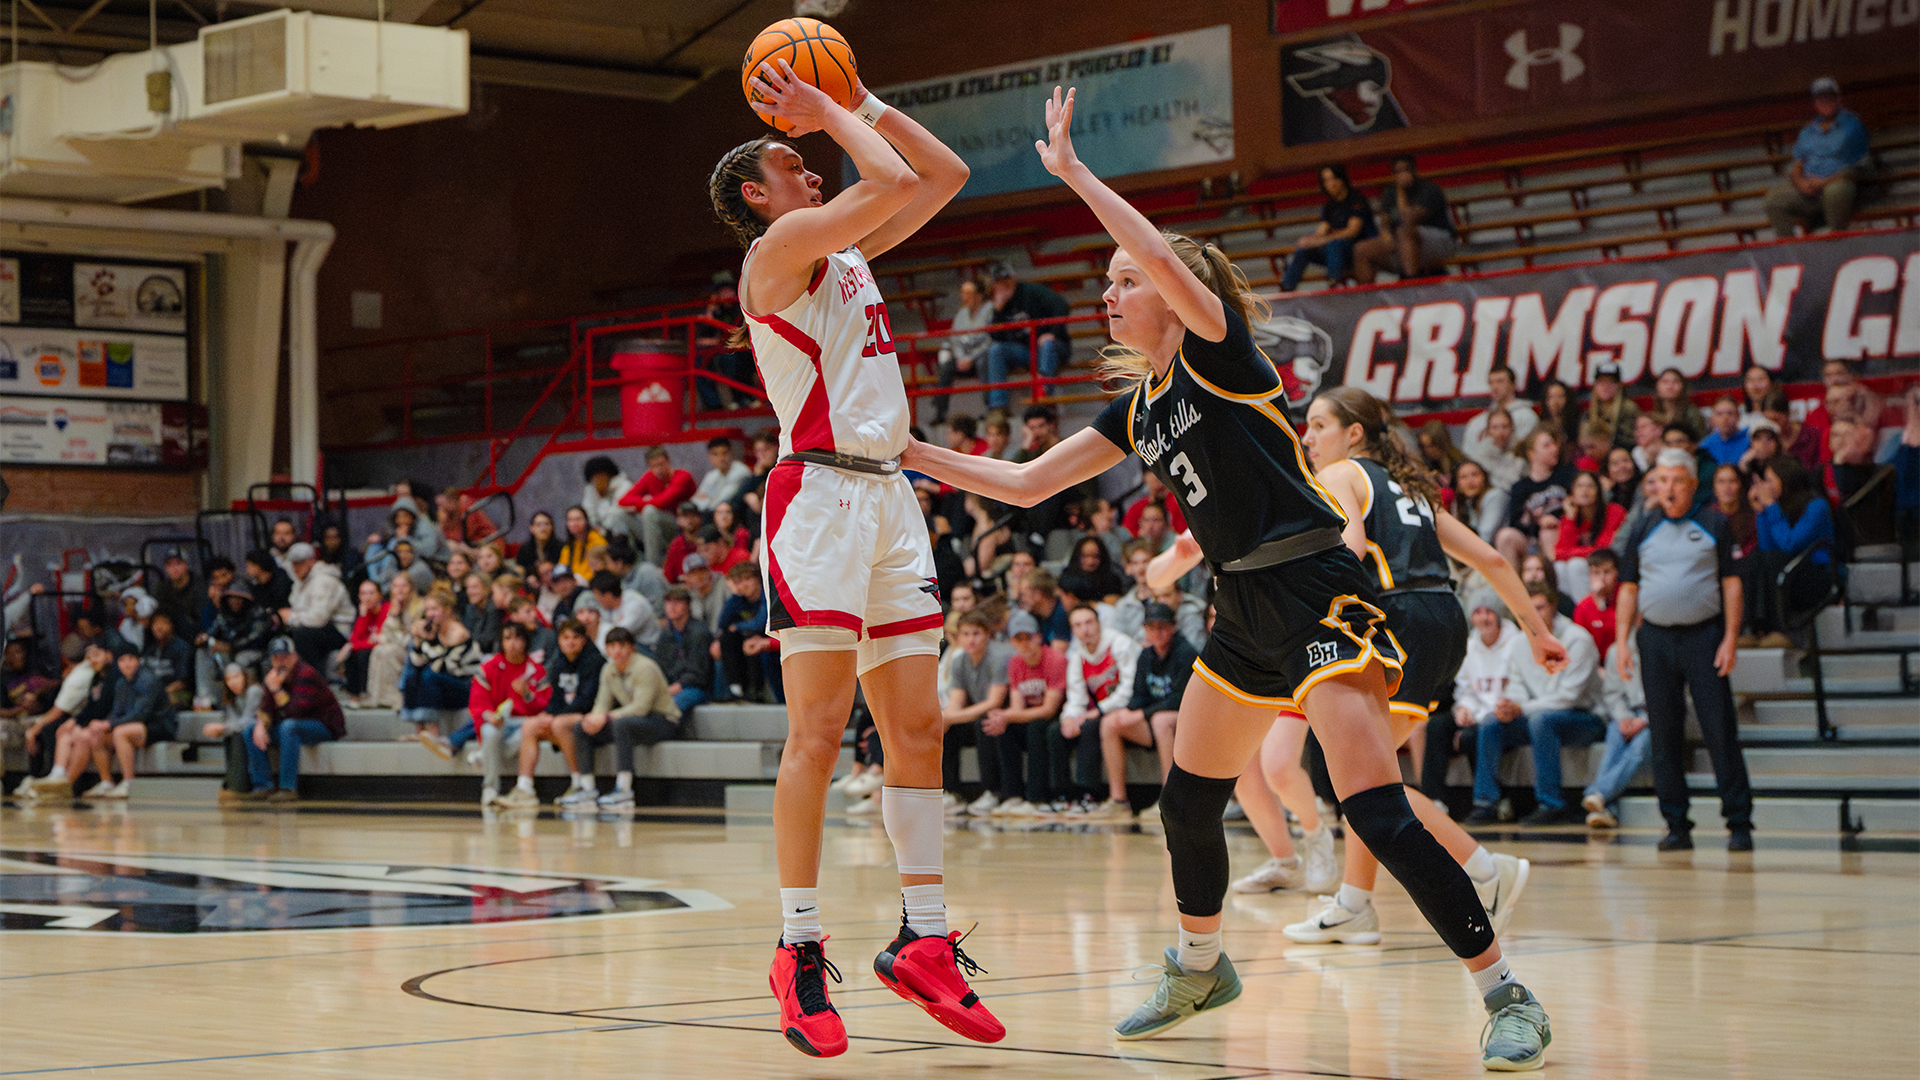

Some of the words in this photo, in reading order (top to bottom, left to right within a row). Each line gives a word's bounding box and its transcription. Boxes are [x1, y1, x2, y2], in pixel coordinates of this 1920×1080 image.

[1046, 61, 1064, 83] IS
[1066, 47, 1147, 80] POWERED
[1150, 42, 1175, 66] BY
[1121, 98, 1200, 127] HEALTH
[861, 302, 897, 358] 20
[1343, 263, 1805, 403] CRIMSON
[1169, 450, 1208, 508] 3
[1305, 640, 1339, 668] BH
